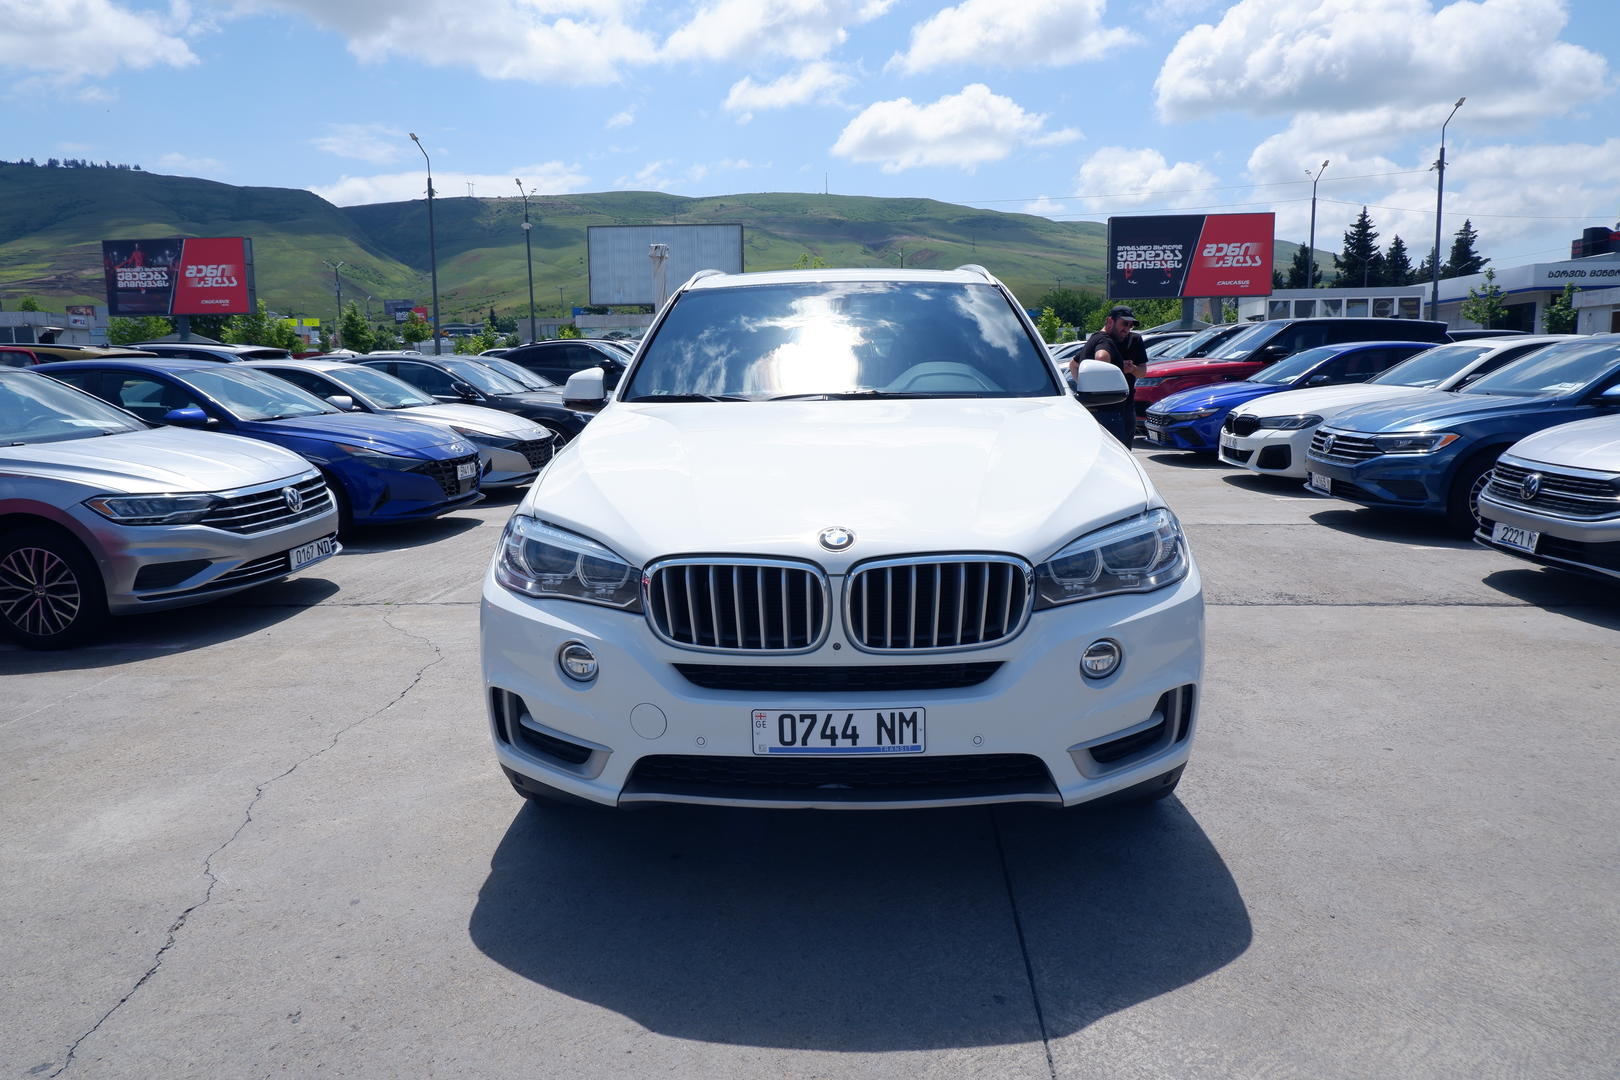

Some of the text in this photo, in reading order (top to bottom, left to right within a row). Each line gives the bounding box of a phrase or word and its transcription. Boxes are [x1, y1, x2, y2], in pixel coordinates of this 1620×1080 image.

[1501, 526, 1524, 545] 2221
[296, 539, 330, 564] 0167 ND
[755, 720, 767, 729] GE
[778, 711, 918, 747] 0744 NM
